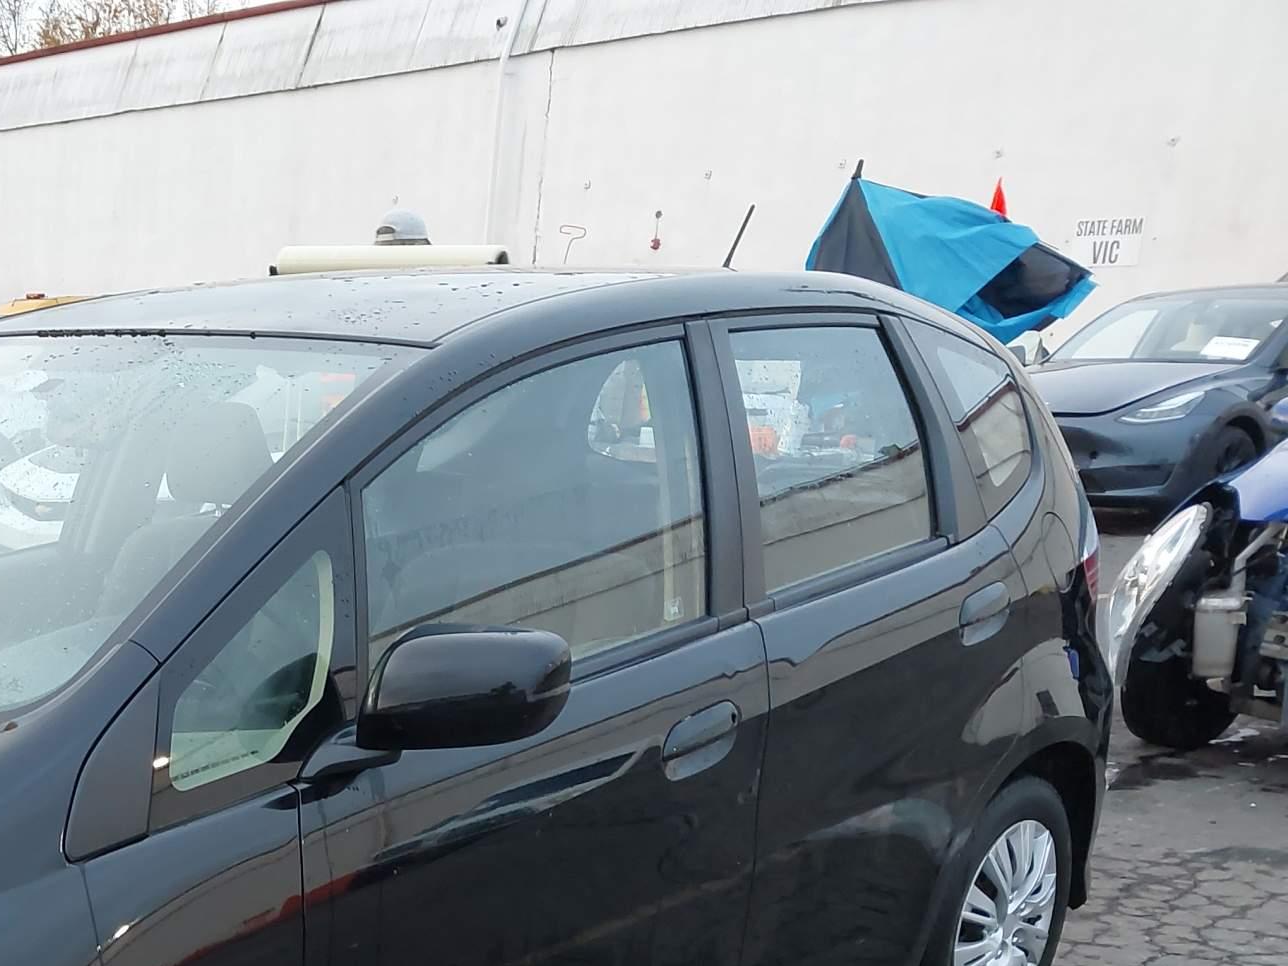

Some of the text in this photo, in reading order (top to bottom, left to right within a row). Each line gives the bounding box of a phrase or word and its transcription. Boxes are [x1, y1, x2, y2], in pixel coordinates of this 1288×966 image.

[1076, 217, 1144, 237] STATE FARM
[1092, 240, 1121, 265] VIC
